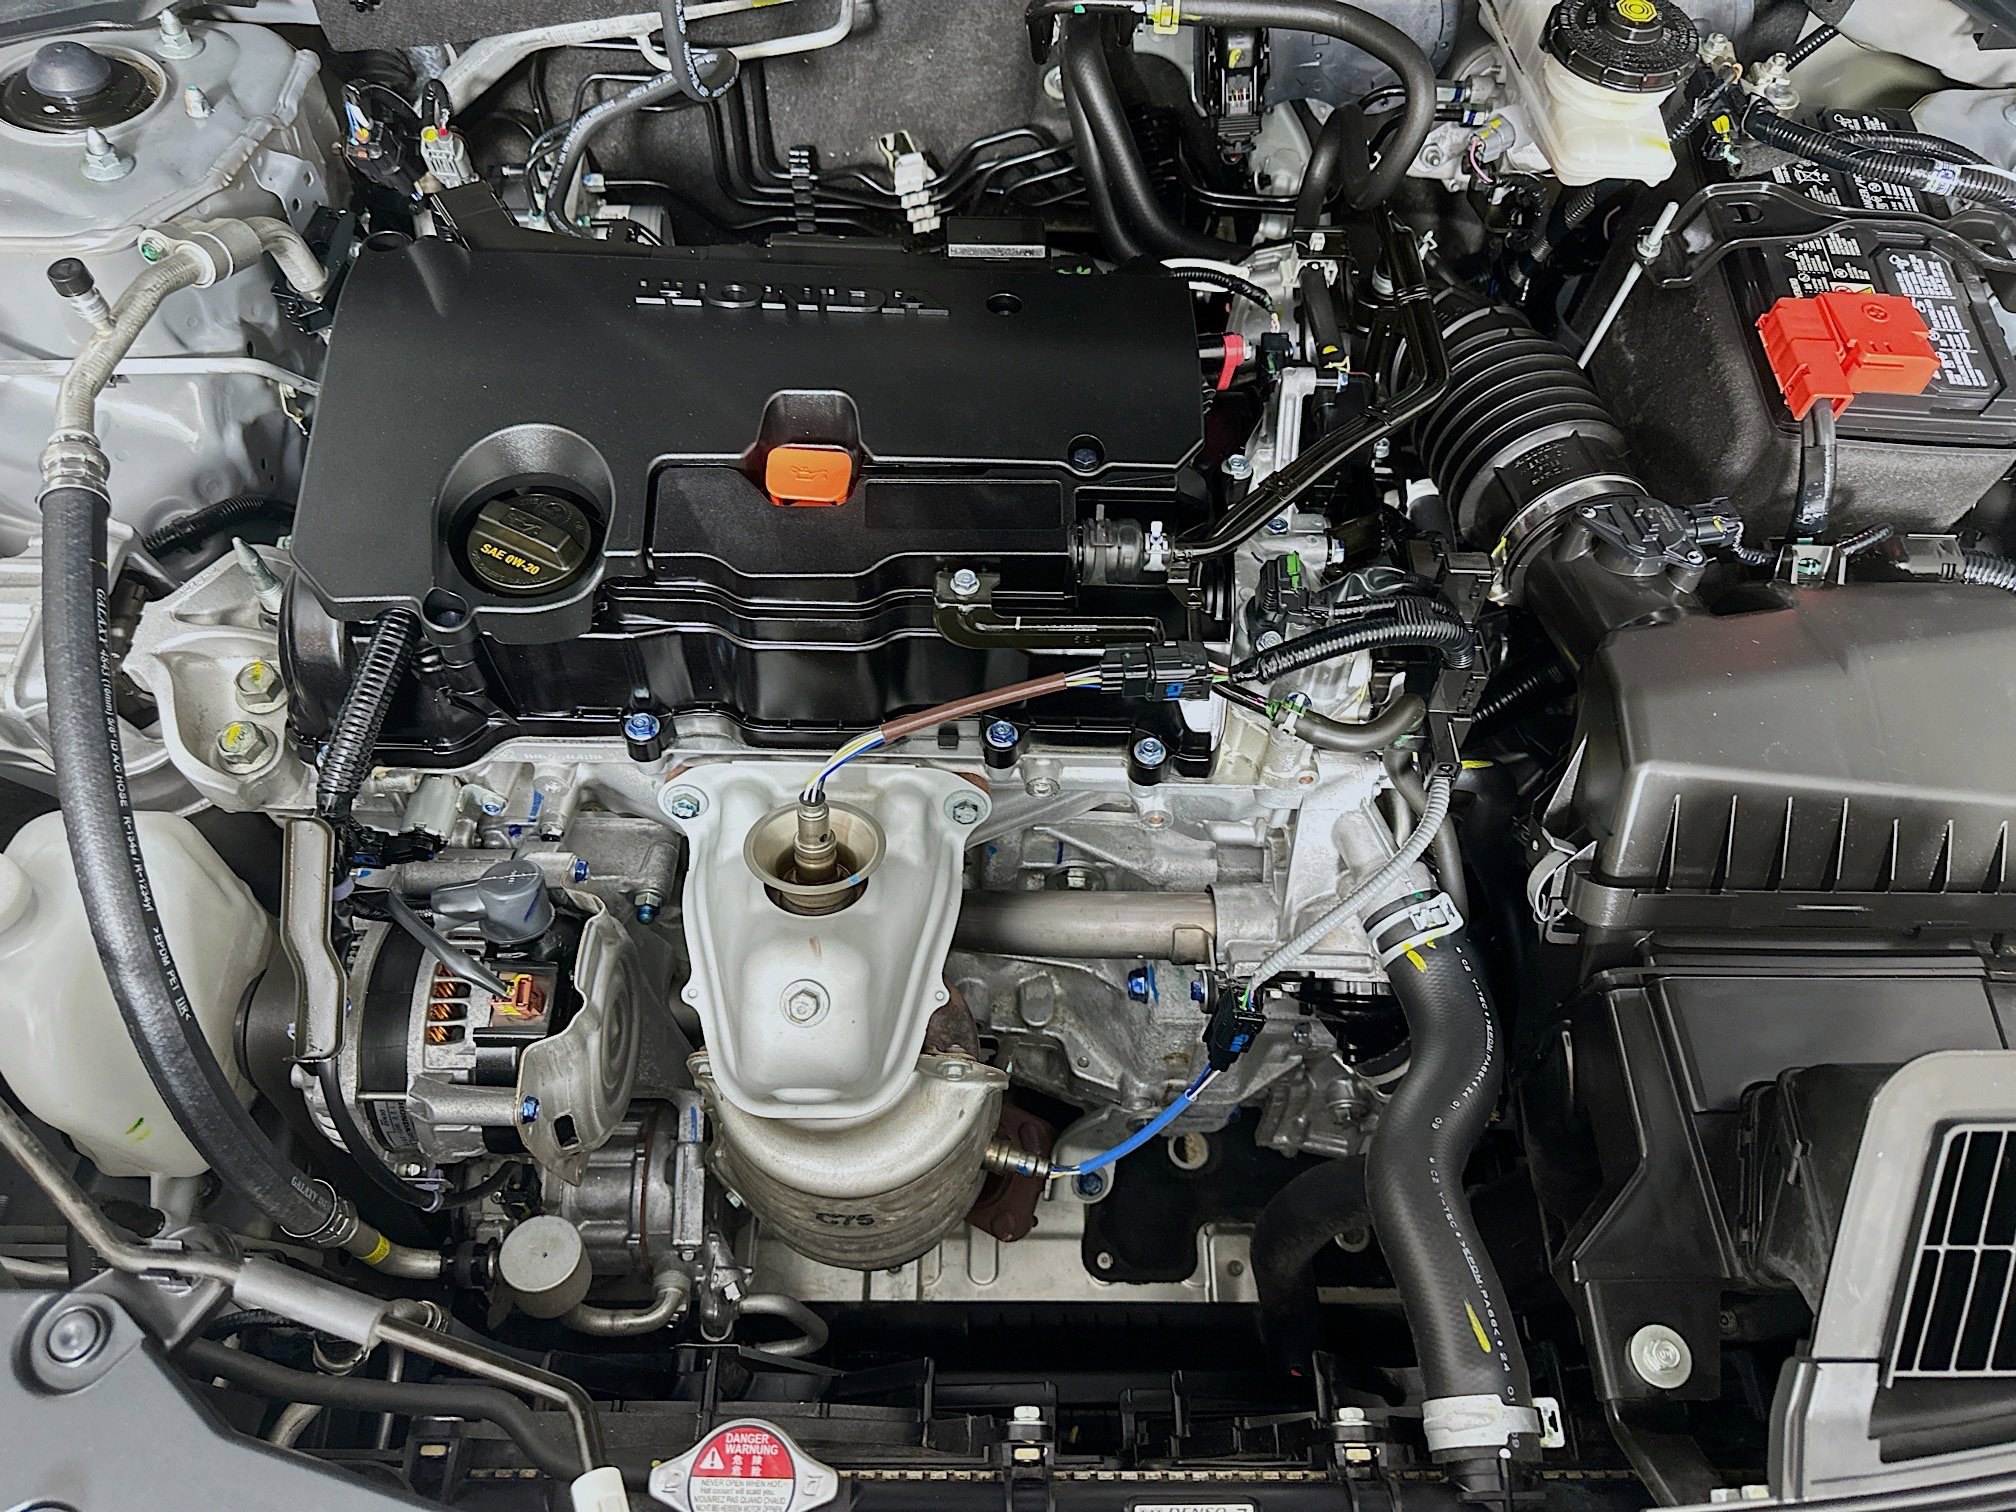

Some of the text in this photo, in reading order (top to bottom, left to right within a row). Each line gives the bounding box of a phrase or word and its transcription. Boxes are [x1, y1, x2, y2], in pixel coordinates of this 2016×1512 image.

[635, 279, 949, 316] HONDA
[480, 543, 507, 560] SAE
[504, 554, 541, 576] 0W-20
[96, 588, 108, 648] GALAXY
[101, 679, 114, 716] (16mm)
[110, 739, 119, 751] ID
[115, 775, 129, 808] HOSE
[166, 969, 180, 991] PET
[1471, 978, 1488, 1010] Y-TEC
[291, 1176, 319, 1203] GALAXY
[1437, 1191, 1458, 1228] Y-TEC
[1499, 1352, 1511, 1372] 24
[725, 1432, 770, 1445] DANGER
[725, 1443, 779, 1456] WARNUNG
[700, 1487, 712, 1495] Hot
[701, 1479, 724, 1487] NEVER
[746, 1480, 766, 1488] WHEN
[727, 1496, 740, 1504] PAS
